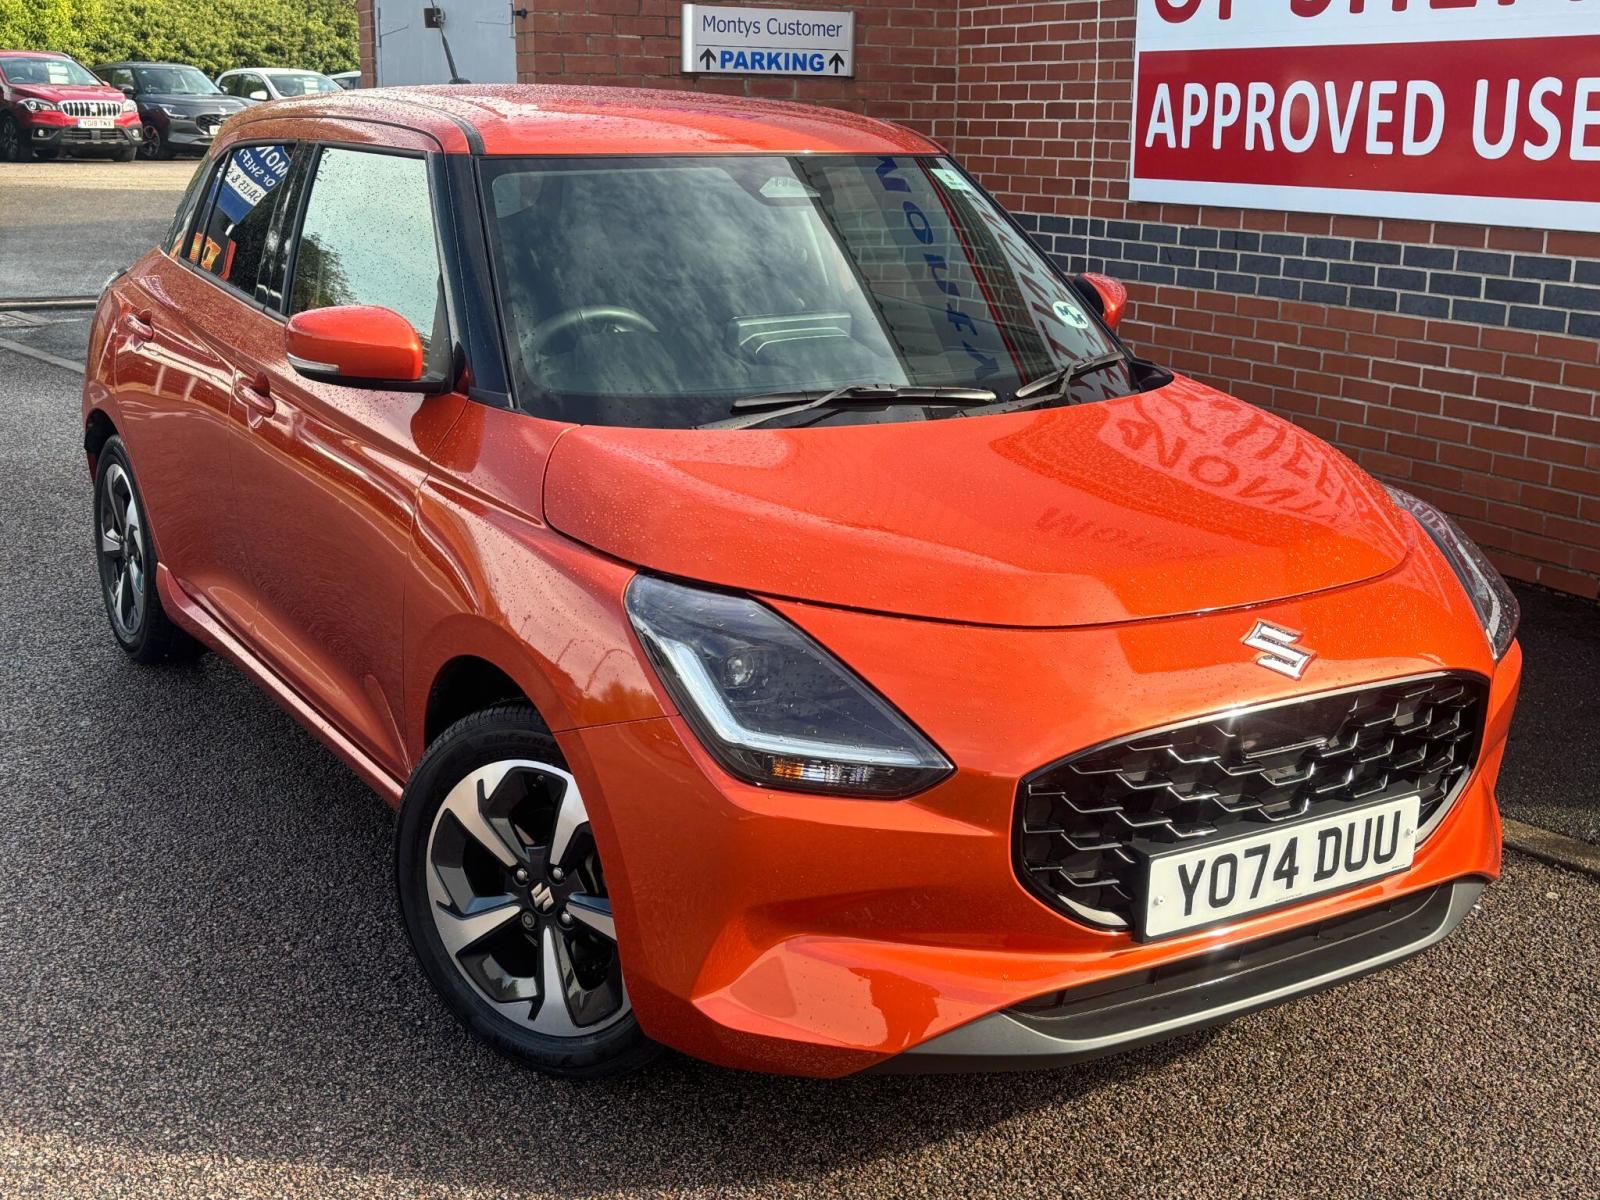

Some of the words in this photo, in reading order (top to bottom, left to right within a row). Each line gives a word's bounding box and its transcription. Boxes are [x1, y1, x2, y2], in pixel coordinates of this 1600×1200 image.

[703, 15, 760, 38] Montys
[766, 18, 842, 37] Customer
[720, 50, 825, 72] PARKING
[1145, 80, 1446, 156] APPROVED
[1472, 77, 1600, 161] USE
[1177, 837, 1299, 916] YO74
[1313, 810, 1402, 882] DUU
